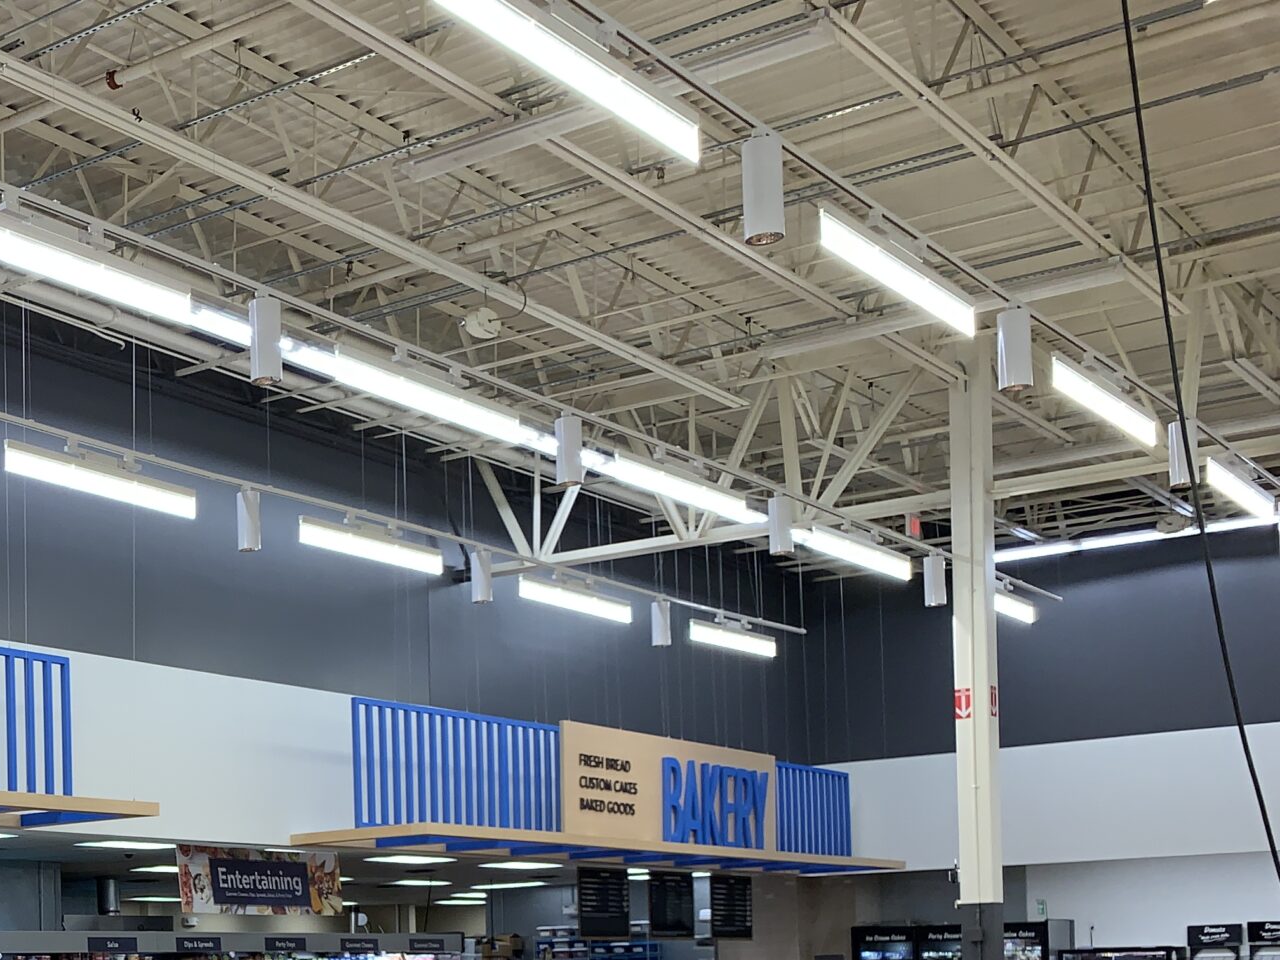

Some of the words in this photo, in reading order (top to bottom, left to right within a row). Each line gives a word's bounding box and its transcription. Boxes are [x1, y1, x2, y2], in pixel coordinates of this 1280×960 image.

[579, 753, 604, 769] FRESH
[605, 757, 631, 773] BREAD
[579, 776, 612, 791] CUSTOM
[613, 780, 638, 795] CAKES
[579, 798, 606, 812] BAKED
[607, 801, 635, 816] GOODS
[662, 756, 769, 850] BAKERY
[217, 867, 302, 896] Entertaining
